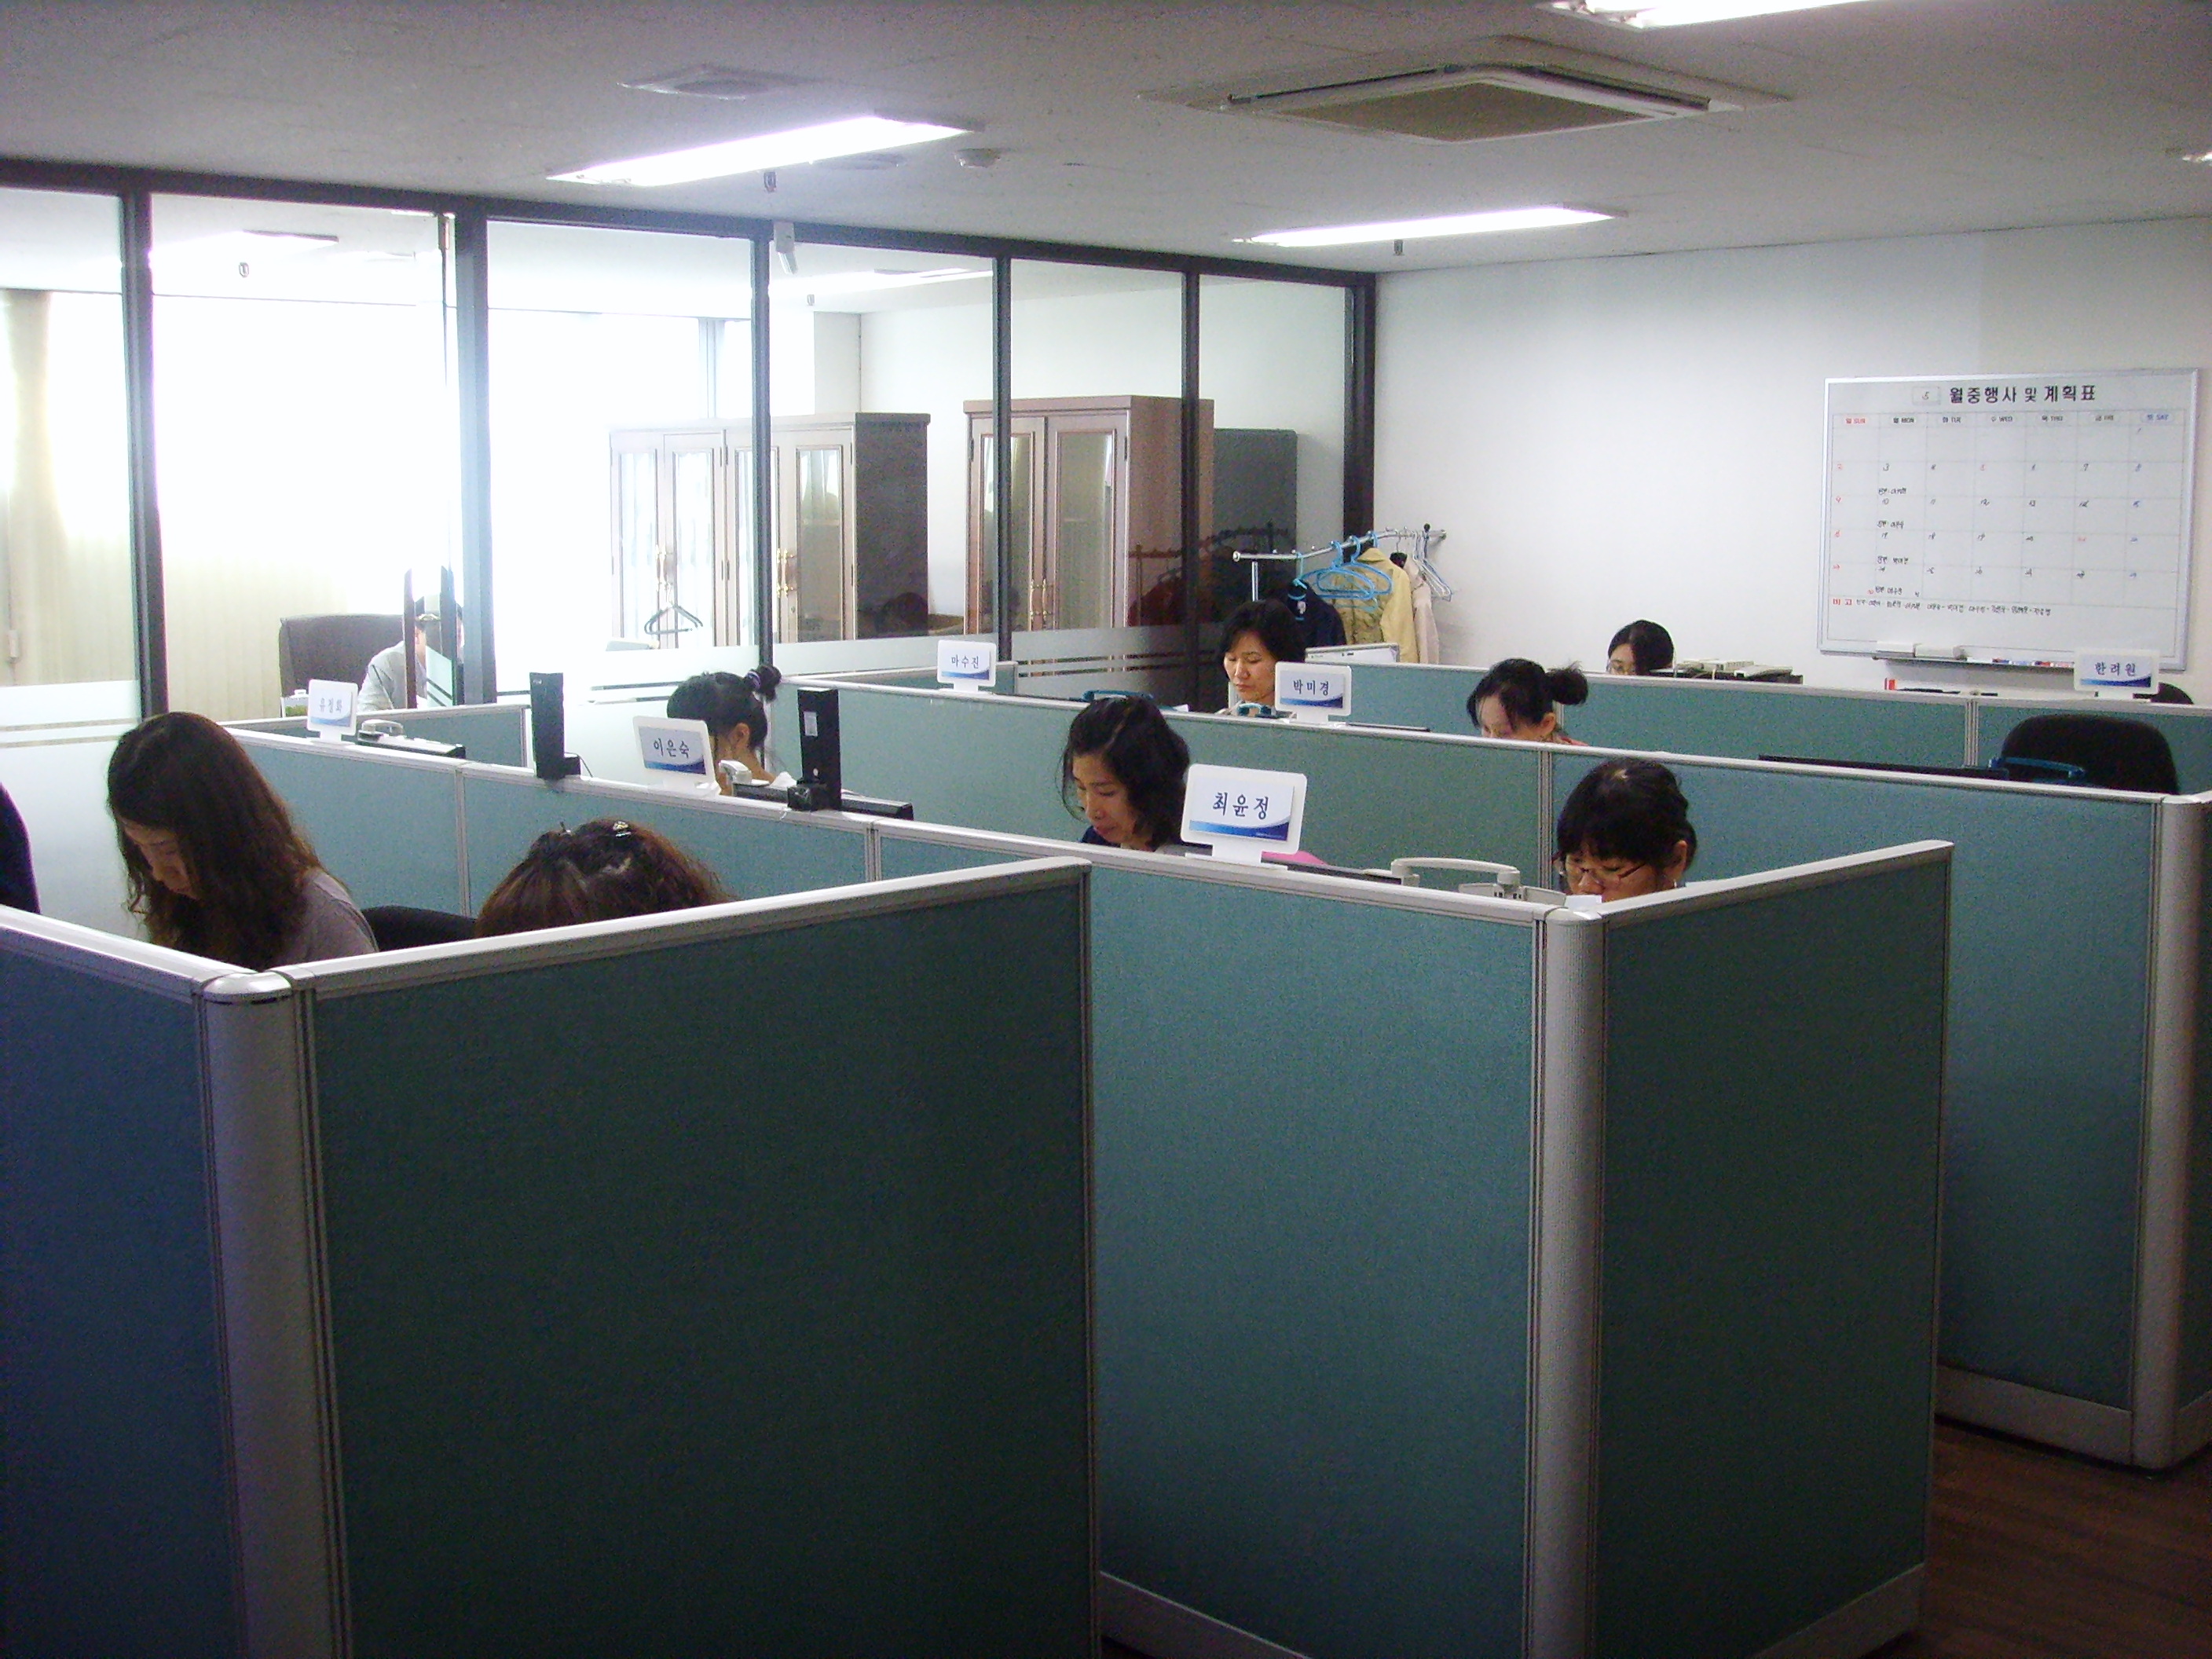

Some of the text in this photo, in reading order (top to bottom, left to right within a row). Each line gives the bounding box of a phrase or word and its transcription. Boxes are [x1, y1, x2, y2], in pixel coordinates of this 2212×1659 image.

[1949, 385, 2096, 404] 월중행사 및 계획표
[950, 654, 979, 669] 마수진
[1293, 679, 1329, 696] 박미경
[653, 738, 690, 759] 이은숙
[1212, 792, 1269, 820] 최윤정
